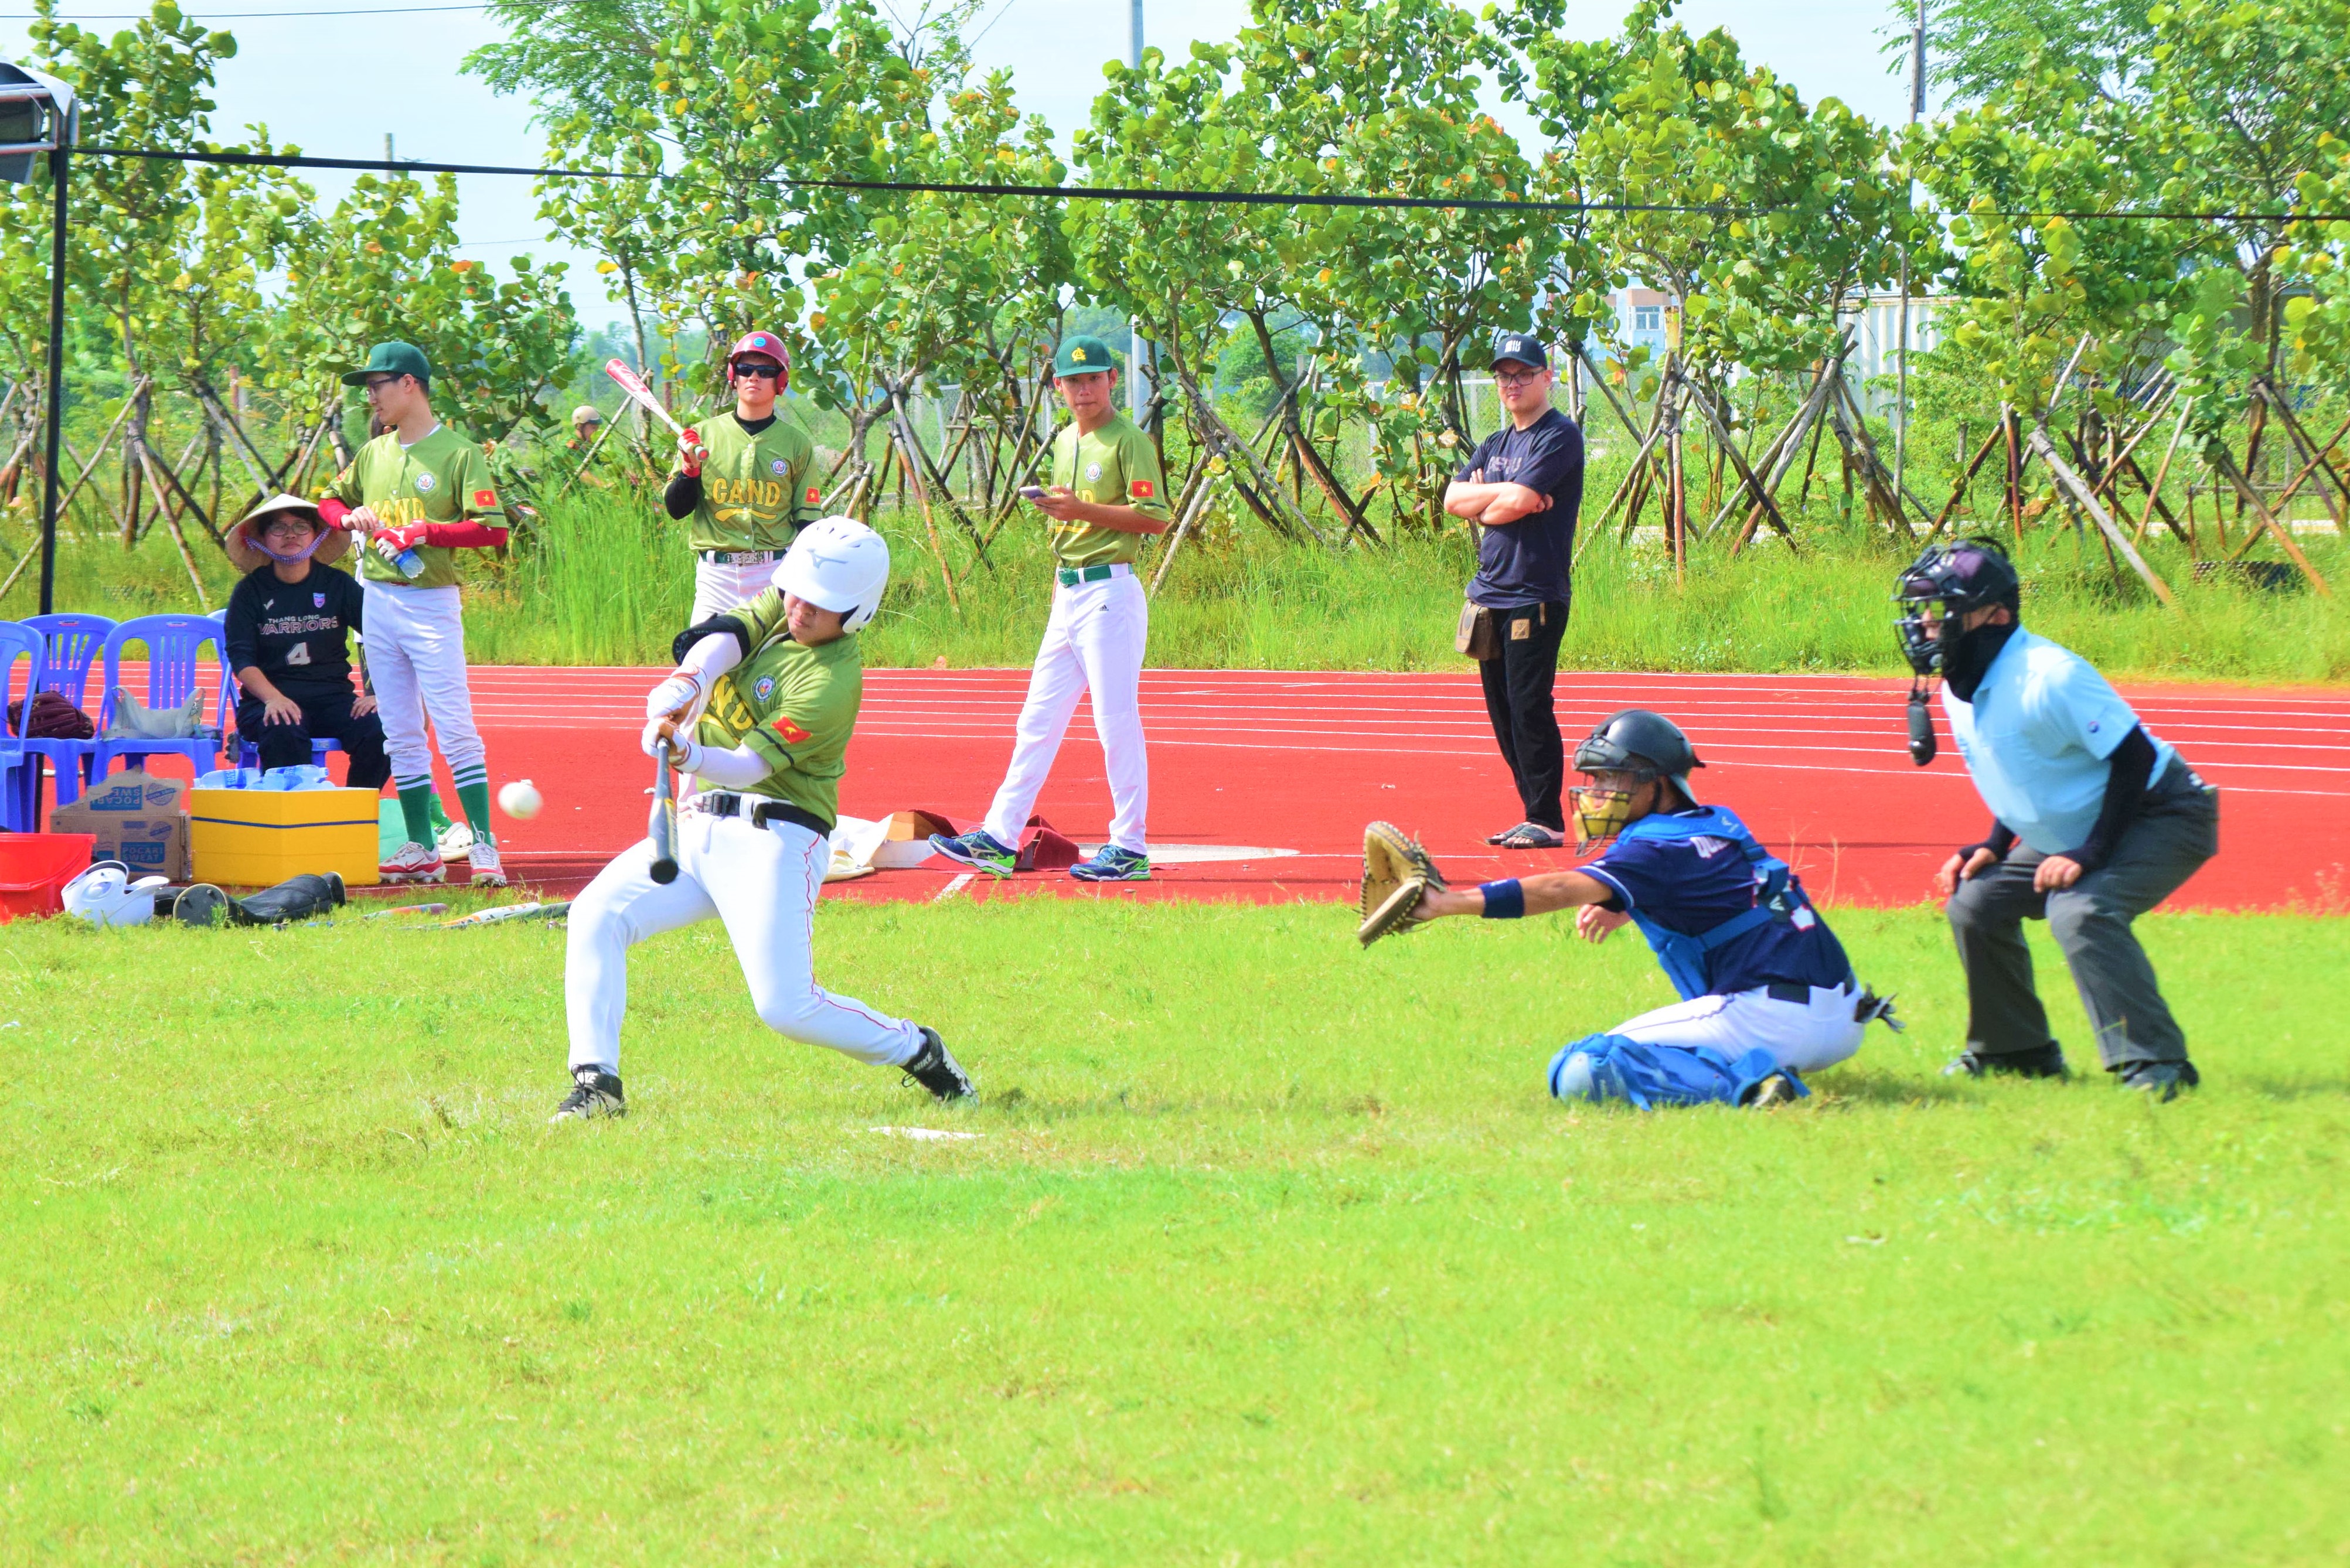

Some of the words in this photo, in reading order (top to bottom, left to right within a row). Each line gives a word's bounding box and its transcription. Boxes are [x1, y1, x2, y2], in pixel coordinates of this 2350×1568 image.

[712, 477, 781, 507] CAND
[268, 615, 297, 624] THANG
[298, 614, 320, 622] LONG
[285, 642, 312, 666] 4
